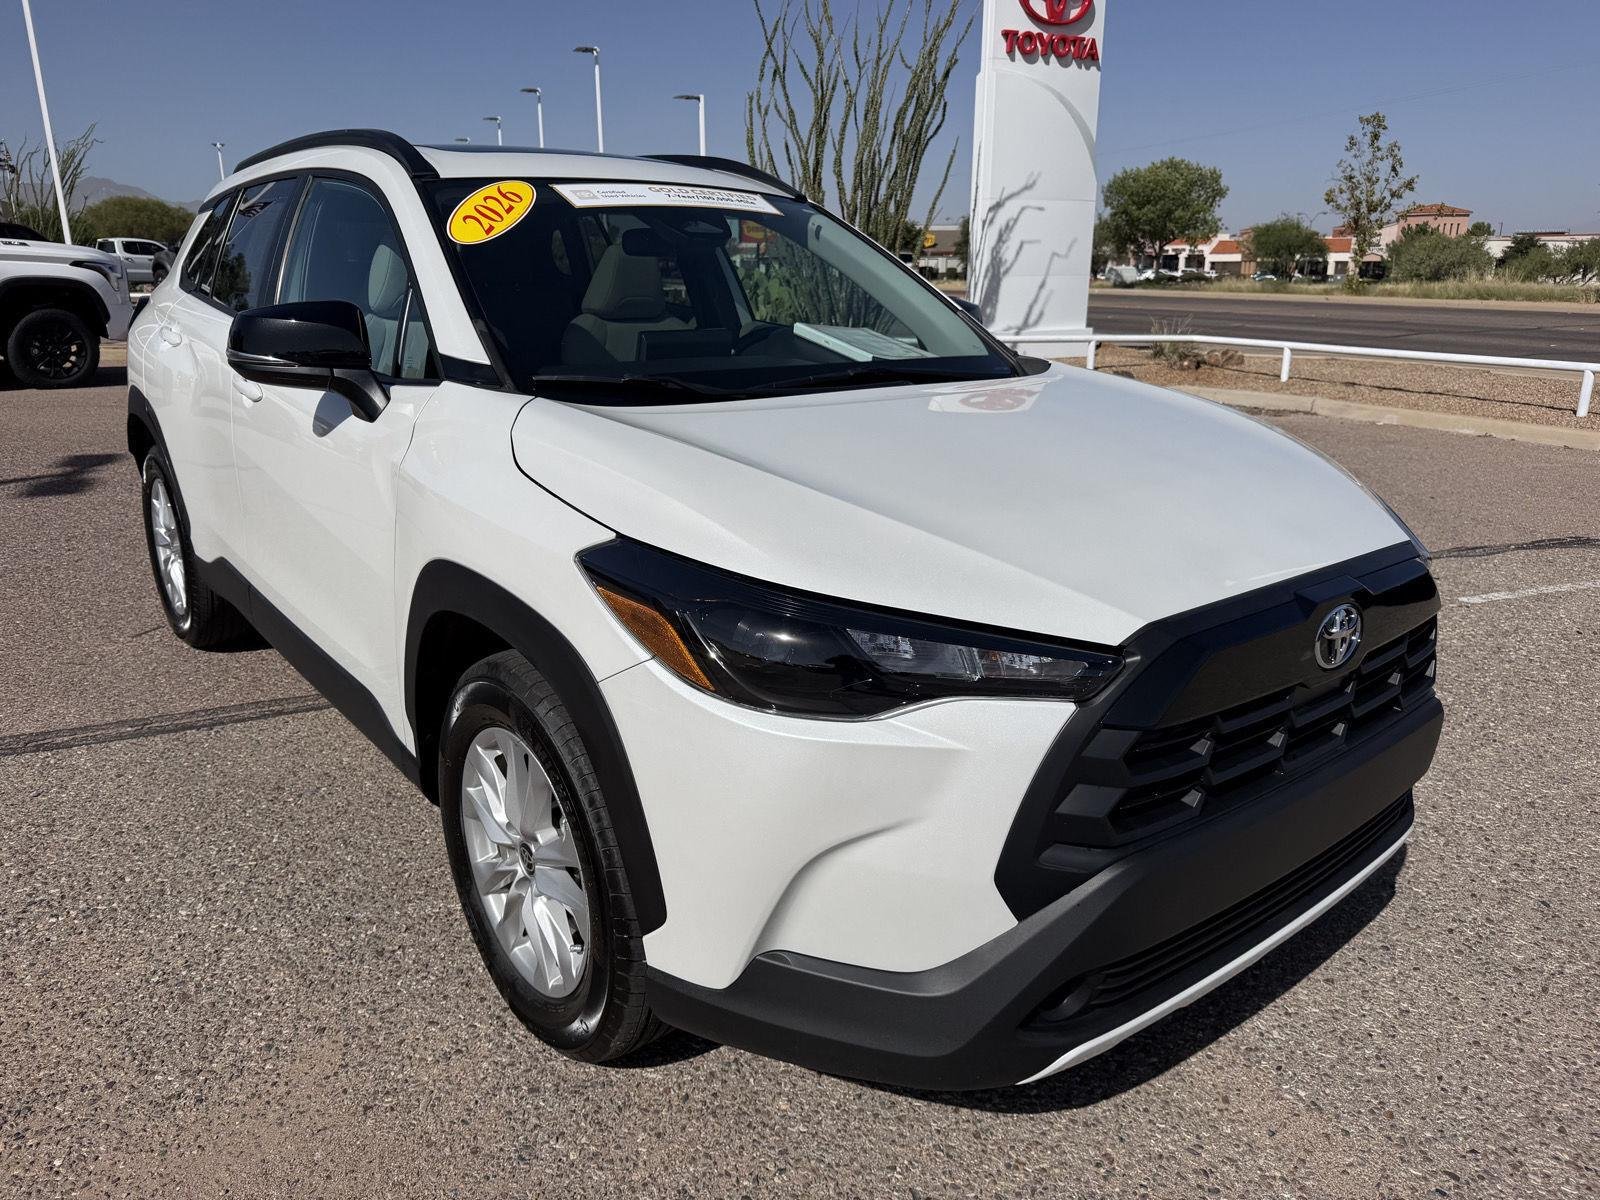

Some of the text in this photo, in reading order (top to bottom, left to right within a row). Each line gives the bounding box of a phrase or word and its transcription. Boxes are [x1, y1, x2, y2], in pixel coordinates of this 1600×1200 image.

[1001, 29, 1100, 61] TOYOTA
[648, 186, 757, 201] GOLD CERTIFIED
[462, 185, 524, 236] 2026
